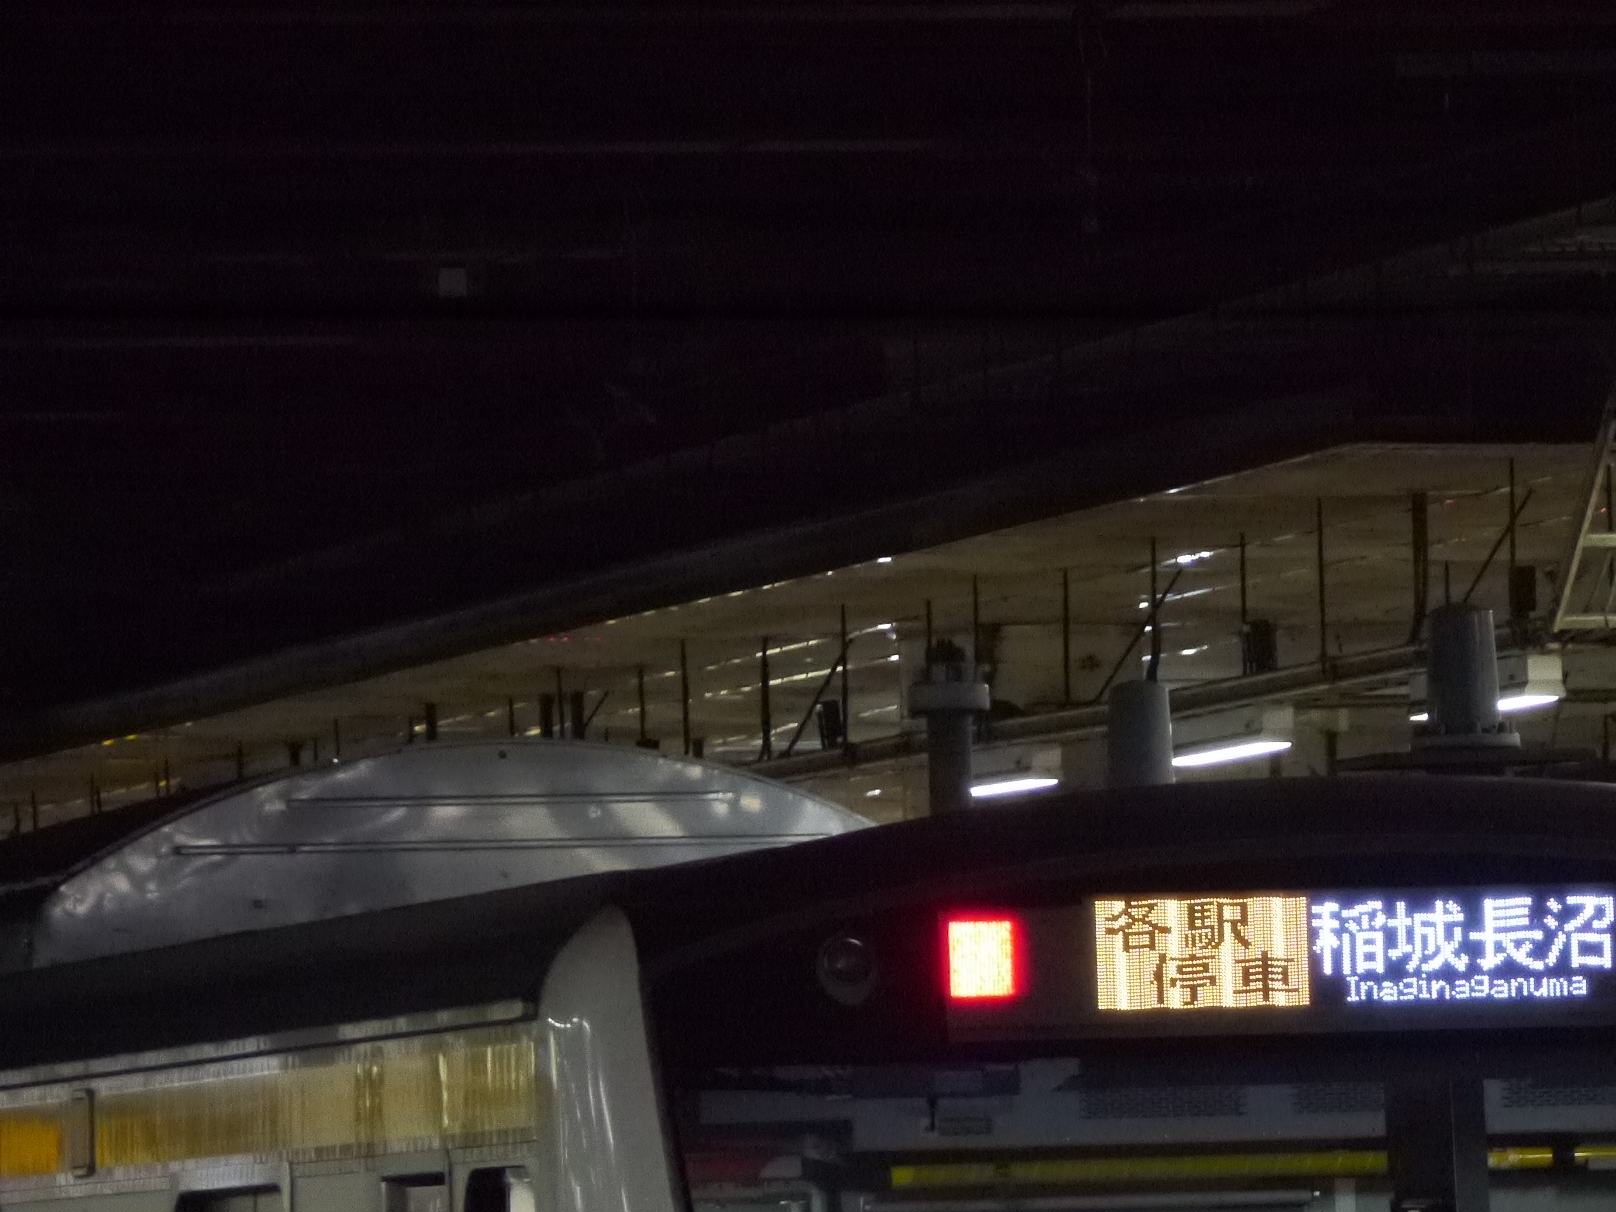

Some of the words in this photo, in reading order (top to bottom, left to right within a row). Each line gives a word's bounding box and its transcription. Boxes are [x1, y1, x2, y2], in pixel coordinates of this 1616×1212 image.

[1104, 899, 1253, 952] 各駅
[1311, 895, 1615, 976] 稲城長沼
[1153, 950, 1301, 1005] 停車
[1346, 973, 1588, 1002] Inaginaganuma
